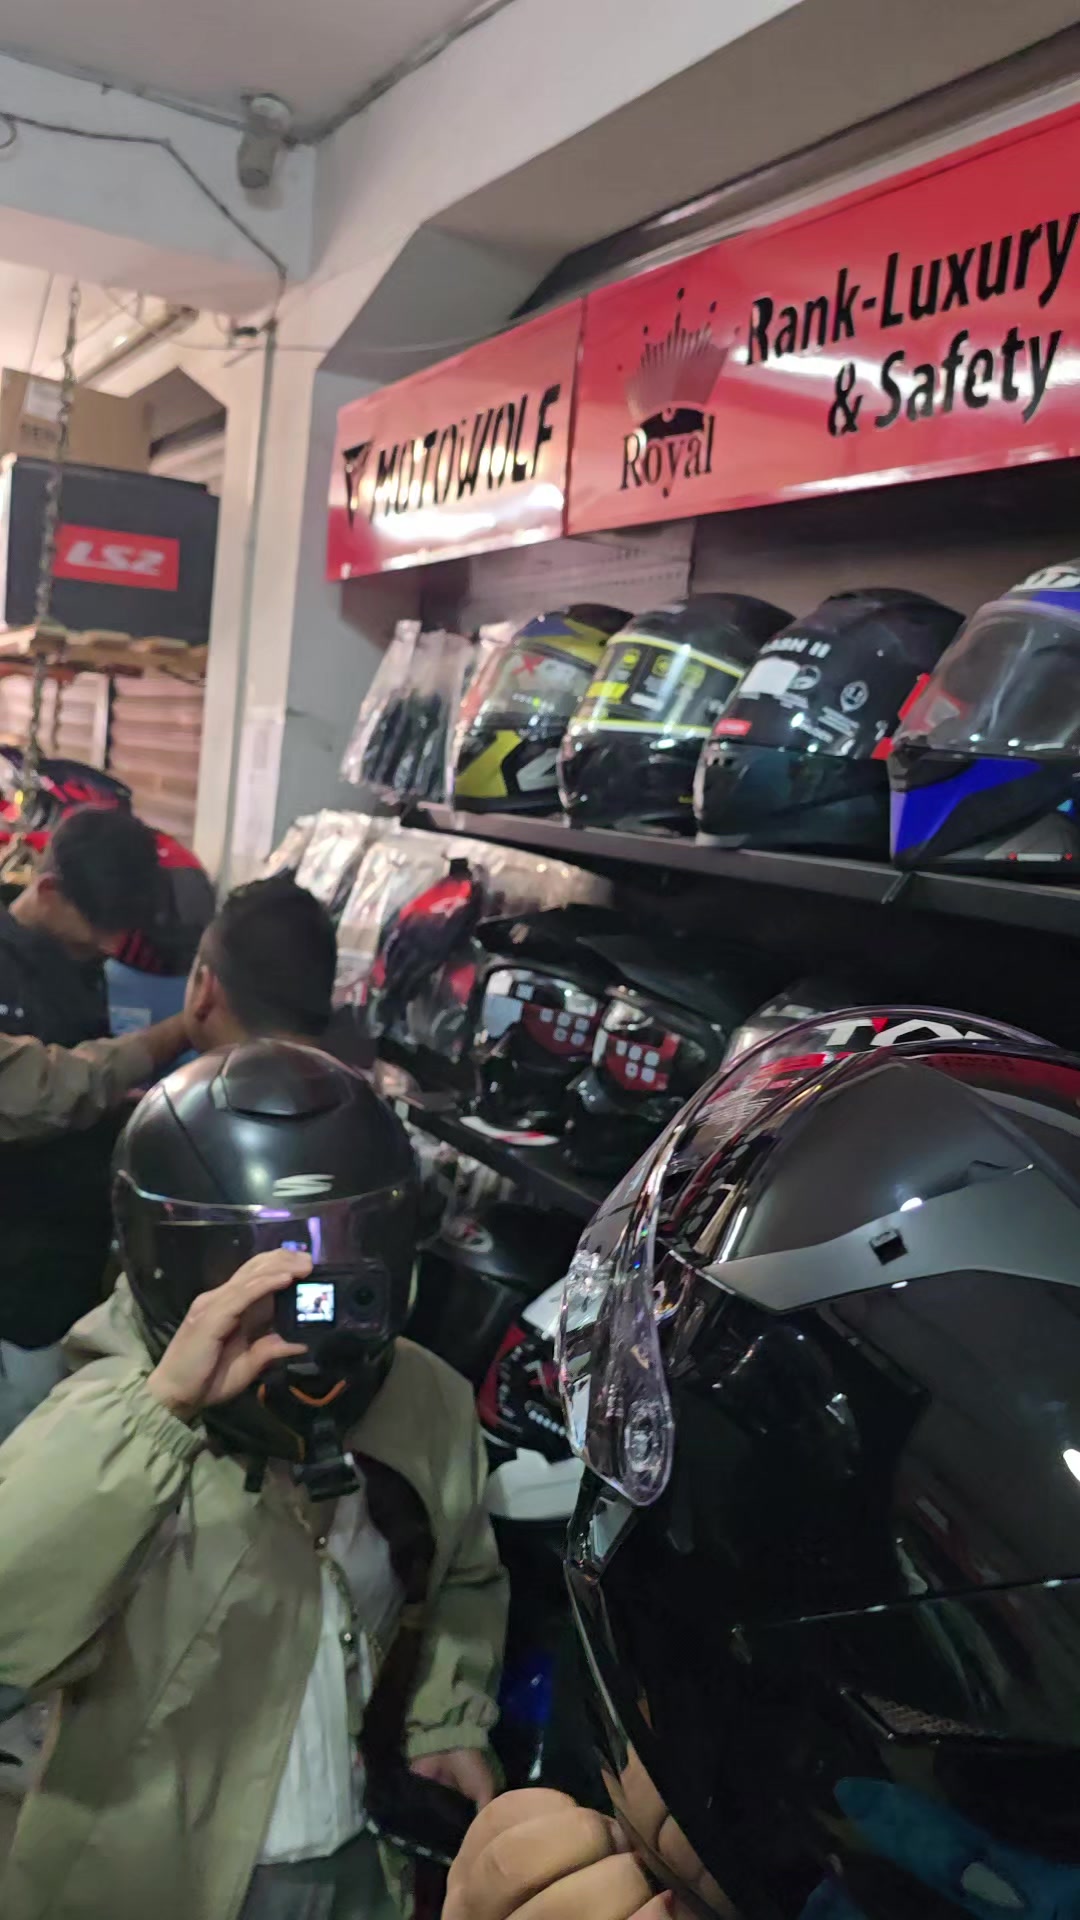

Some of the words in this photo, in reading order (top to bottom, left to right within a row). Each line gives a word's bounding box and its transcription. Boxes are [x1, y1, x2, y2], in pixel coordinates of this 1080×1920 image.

[745, 213, 1080, 366] Rank-Luxury
[828, 362, 863, 436] &
[873, 328, 1063, 429] Safety
[620, 415, 715, 498] Royal
[65, 541, 165, 577] LS2
